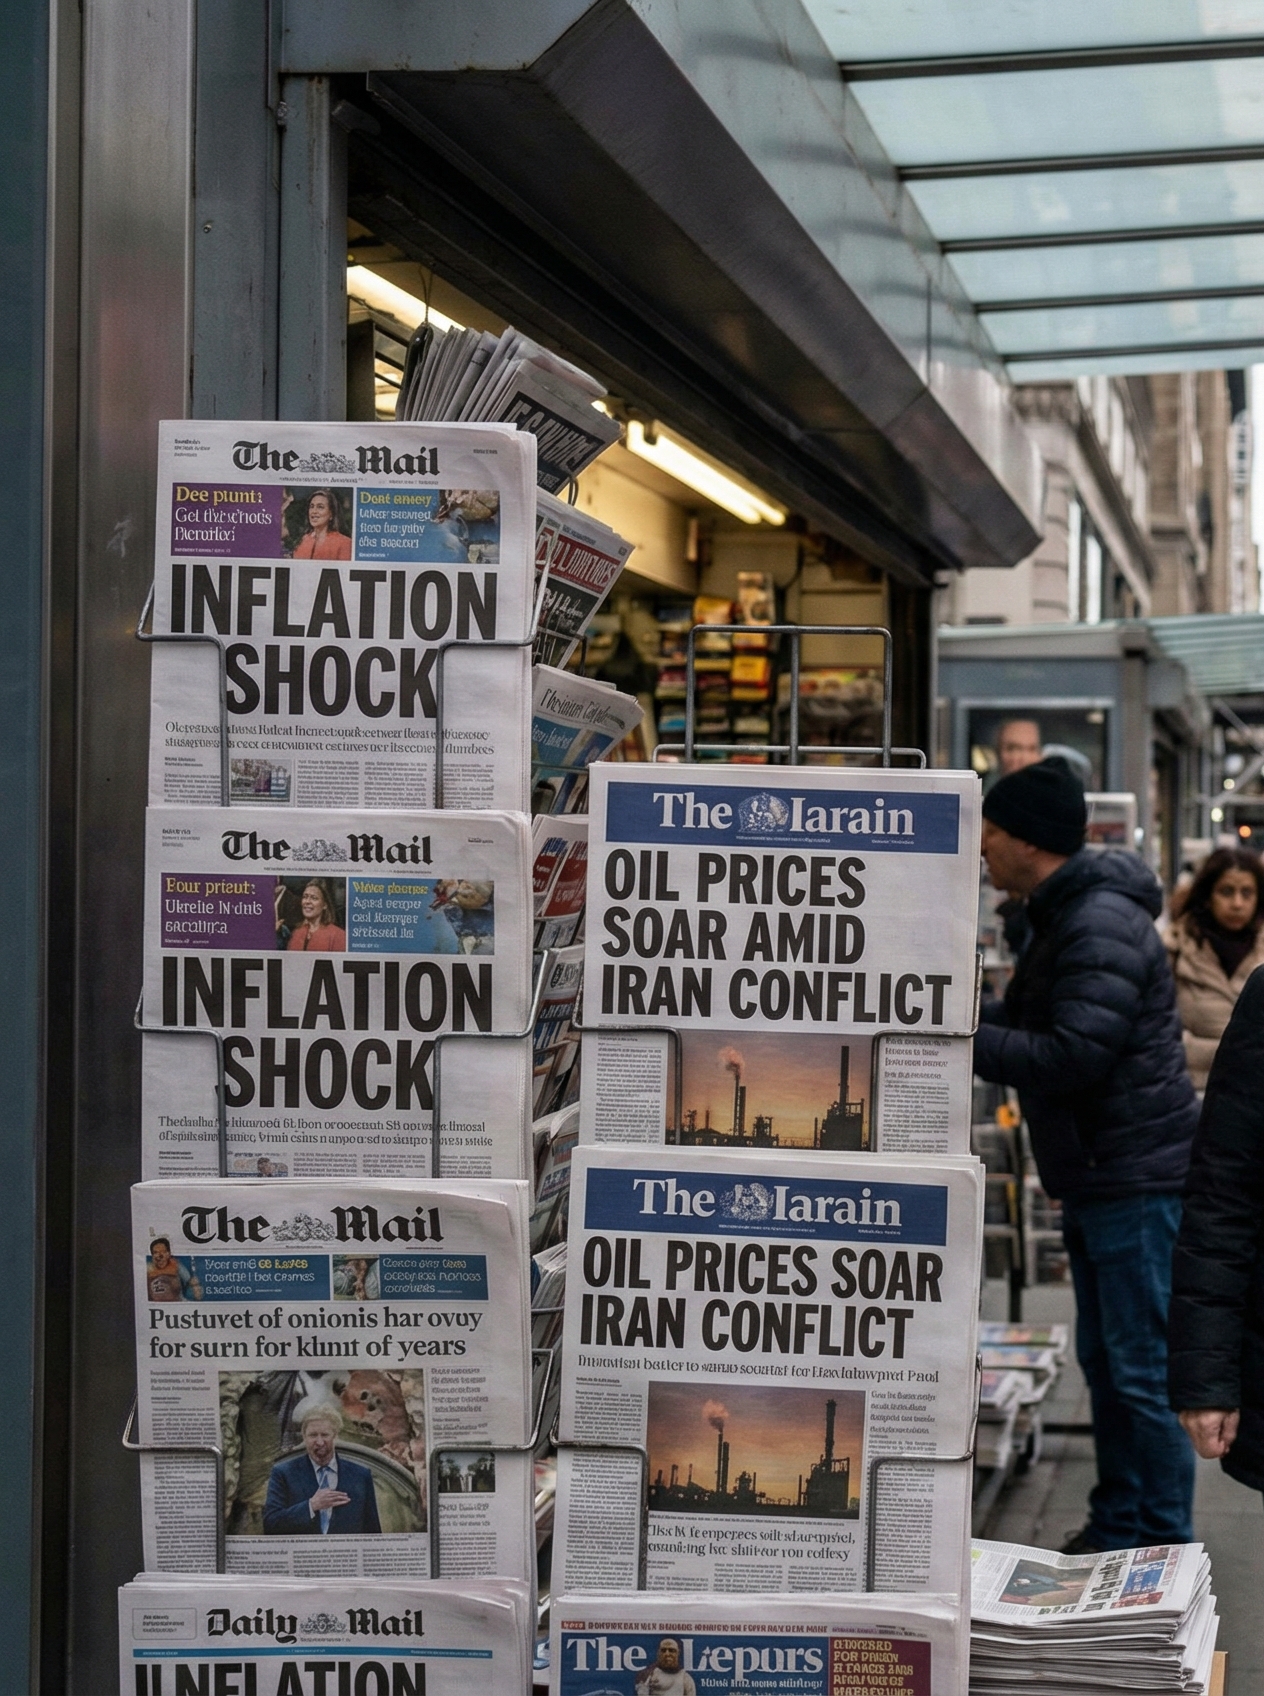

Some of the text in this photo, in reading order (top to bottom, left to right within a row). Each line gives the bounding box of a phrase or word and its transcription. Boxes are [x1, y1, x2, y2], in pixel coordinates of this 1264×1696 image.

[232, 440, 300, 472] The
[355, 445, 441, 476] Mail
[170, 563, 498, 641] INFLATION
[226, 643, 438, 718] SHOCK
[653, 791, 733, 830] The
[221, 830, 434, 865] The Mail
[604, 848, 866, 909] OIL PRICES
[601, 906, 866, 965] SOAR AMID
[162, 956, 493, 1033] INFLATION
[601, 964, 952, 1026] IRAN CONFLICT
[215, 1035, 436, 1111] SHOCK
[633, 1178, 716, 1218] The
[181, 1205, 444, 1244] The Mail
[582, 1235, 943, 1303] OIL PRICES SOAR
[258, 1306, 283, 1329] of
[287, 1307, 379, 1329] onionis
[383, 1306, 424, 1328] har
[580, 1293, 914, 1359] IRAN CONFLICT
[149, 1336, 186, 1359] for
[190, 1341, 250, 1359] surn
[255, 1335, 292, 1358] for
[365, 1334, 393, 1357] of
[397, 1339, 467, 1362] years
[206, 1607, 298, 1645] Daily
[345, 1607, 426, 1637] Mail
[567, 1636, 648, 1672] The
